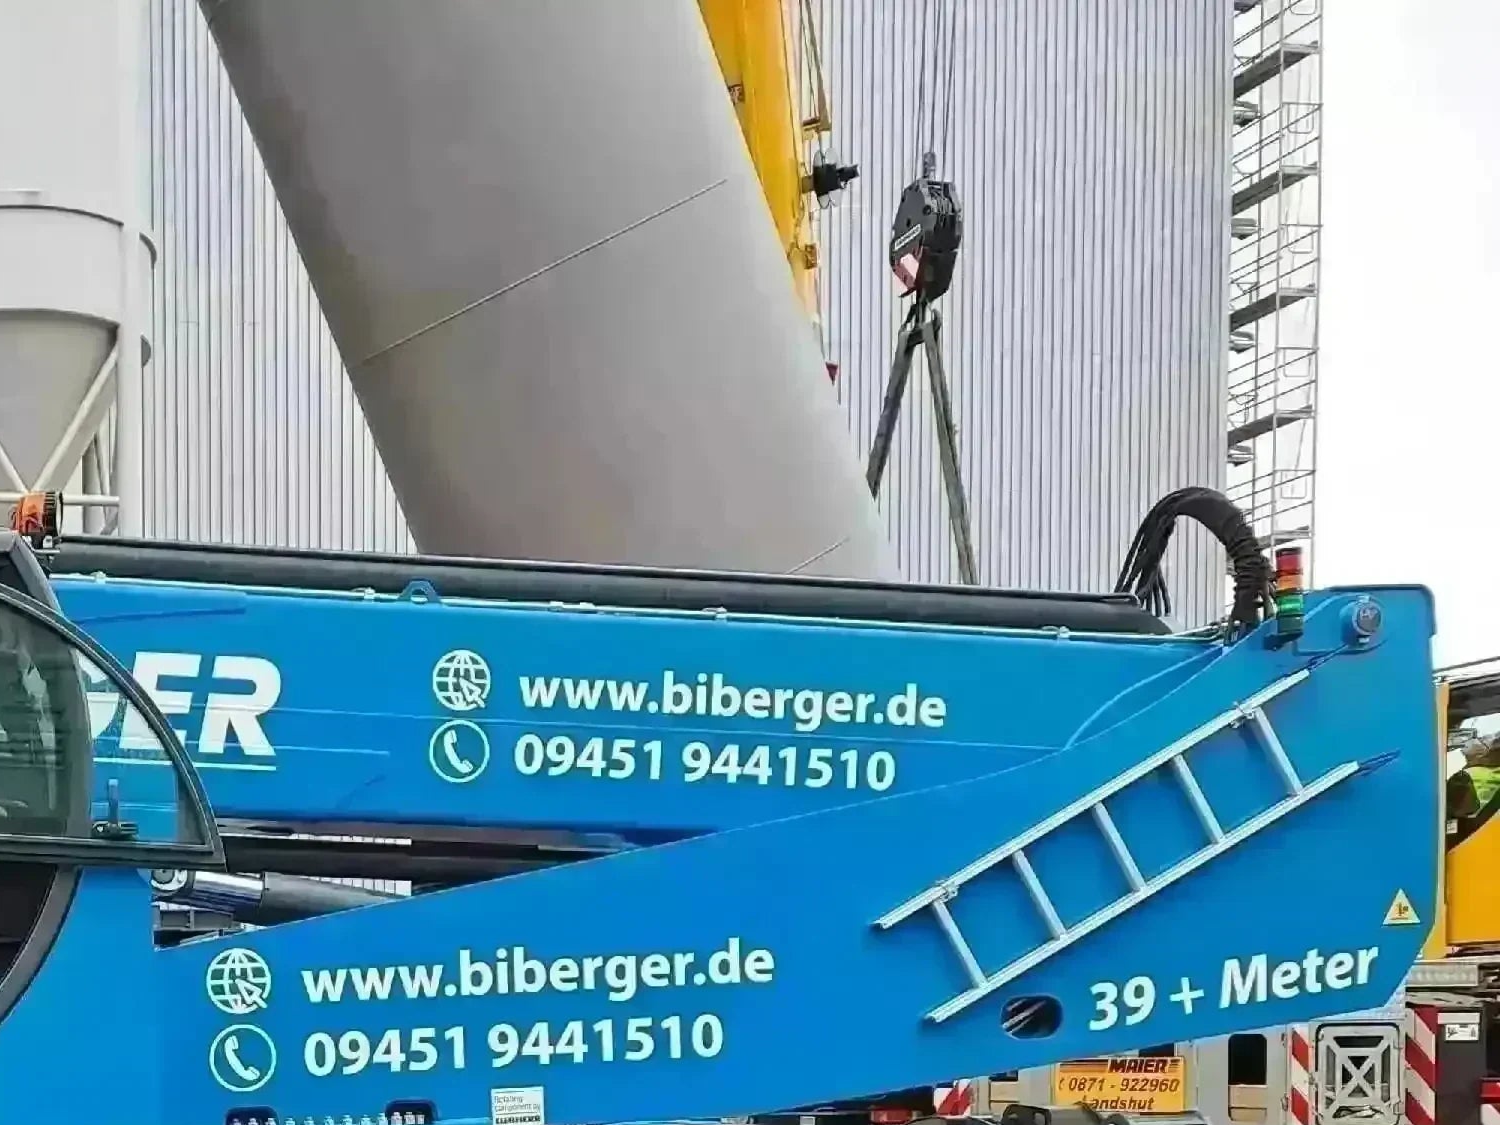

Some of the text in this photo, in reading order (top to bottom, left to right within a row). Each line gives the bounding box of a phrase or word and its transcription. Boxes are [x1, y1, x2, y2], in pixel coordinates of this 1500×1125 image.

[519, 670, 948, 732] www.biberger.de
[514, 734, 896, 791] 09451 9441510
[301, 937, 776, 1002] www.biberger.de
[1088, 945, 1380, 1031] 39 + Meter
[304, 1014, 724, 1077] 09451 9441510
[1108, 1059, 1168, 1073] MAIER
[1068, 1077, 1105, 1092] 0871
[1119, 1078, 1180, 1092] 922960
